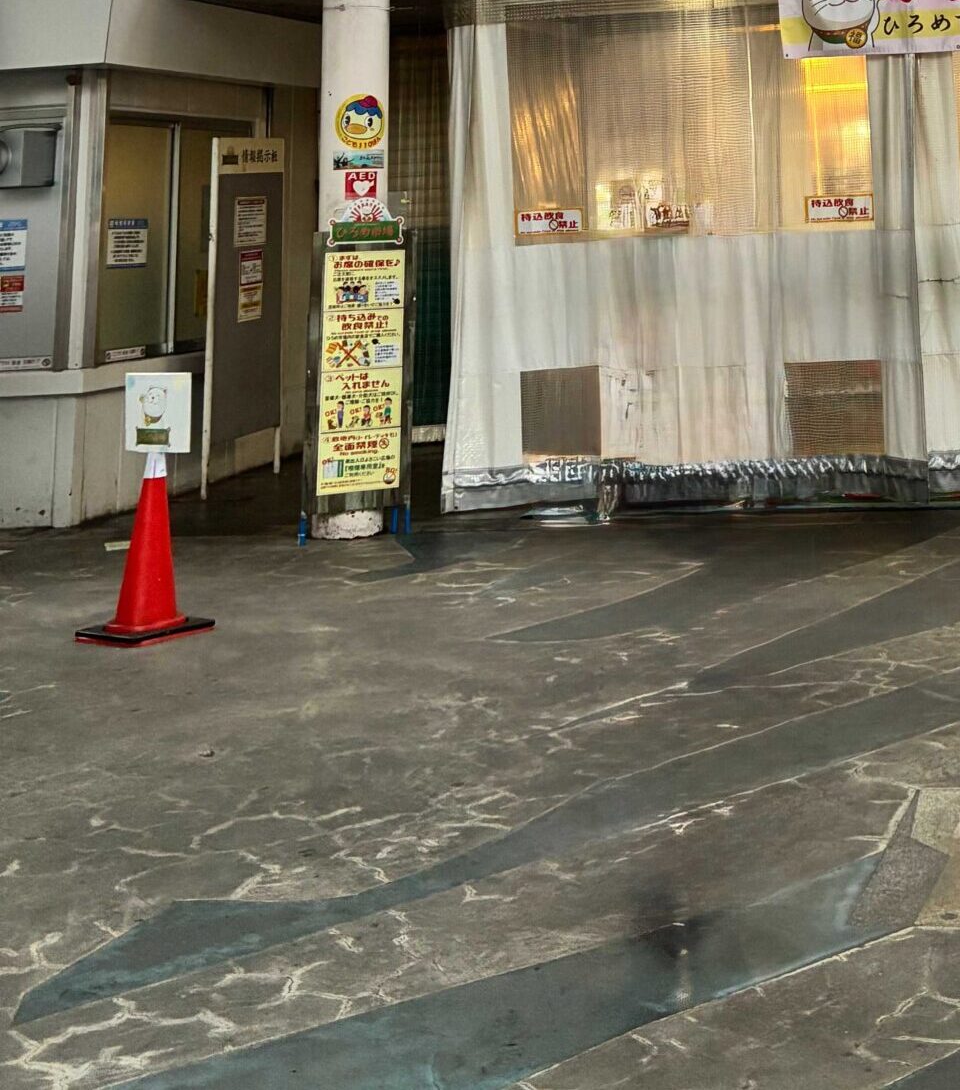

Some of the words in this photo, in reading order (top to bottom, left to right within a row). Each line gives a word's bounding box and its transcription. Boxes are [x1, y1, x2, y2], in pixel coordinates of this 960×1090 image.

[348, 172, 376, 180] AED
[848, 207, 870, 216] 禁止
[558, 220, 578, 229] 禁止
[336, 372, 368, 381] ペットは
[342, 380, 390, 390] 入れません
